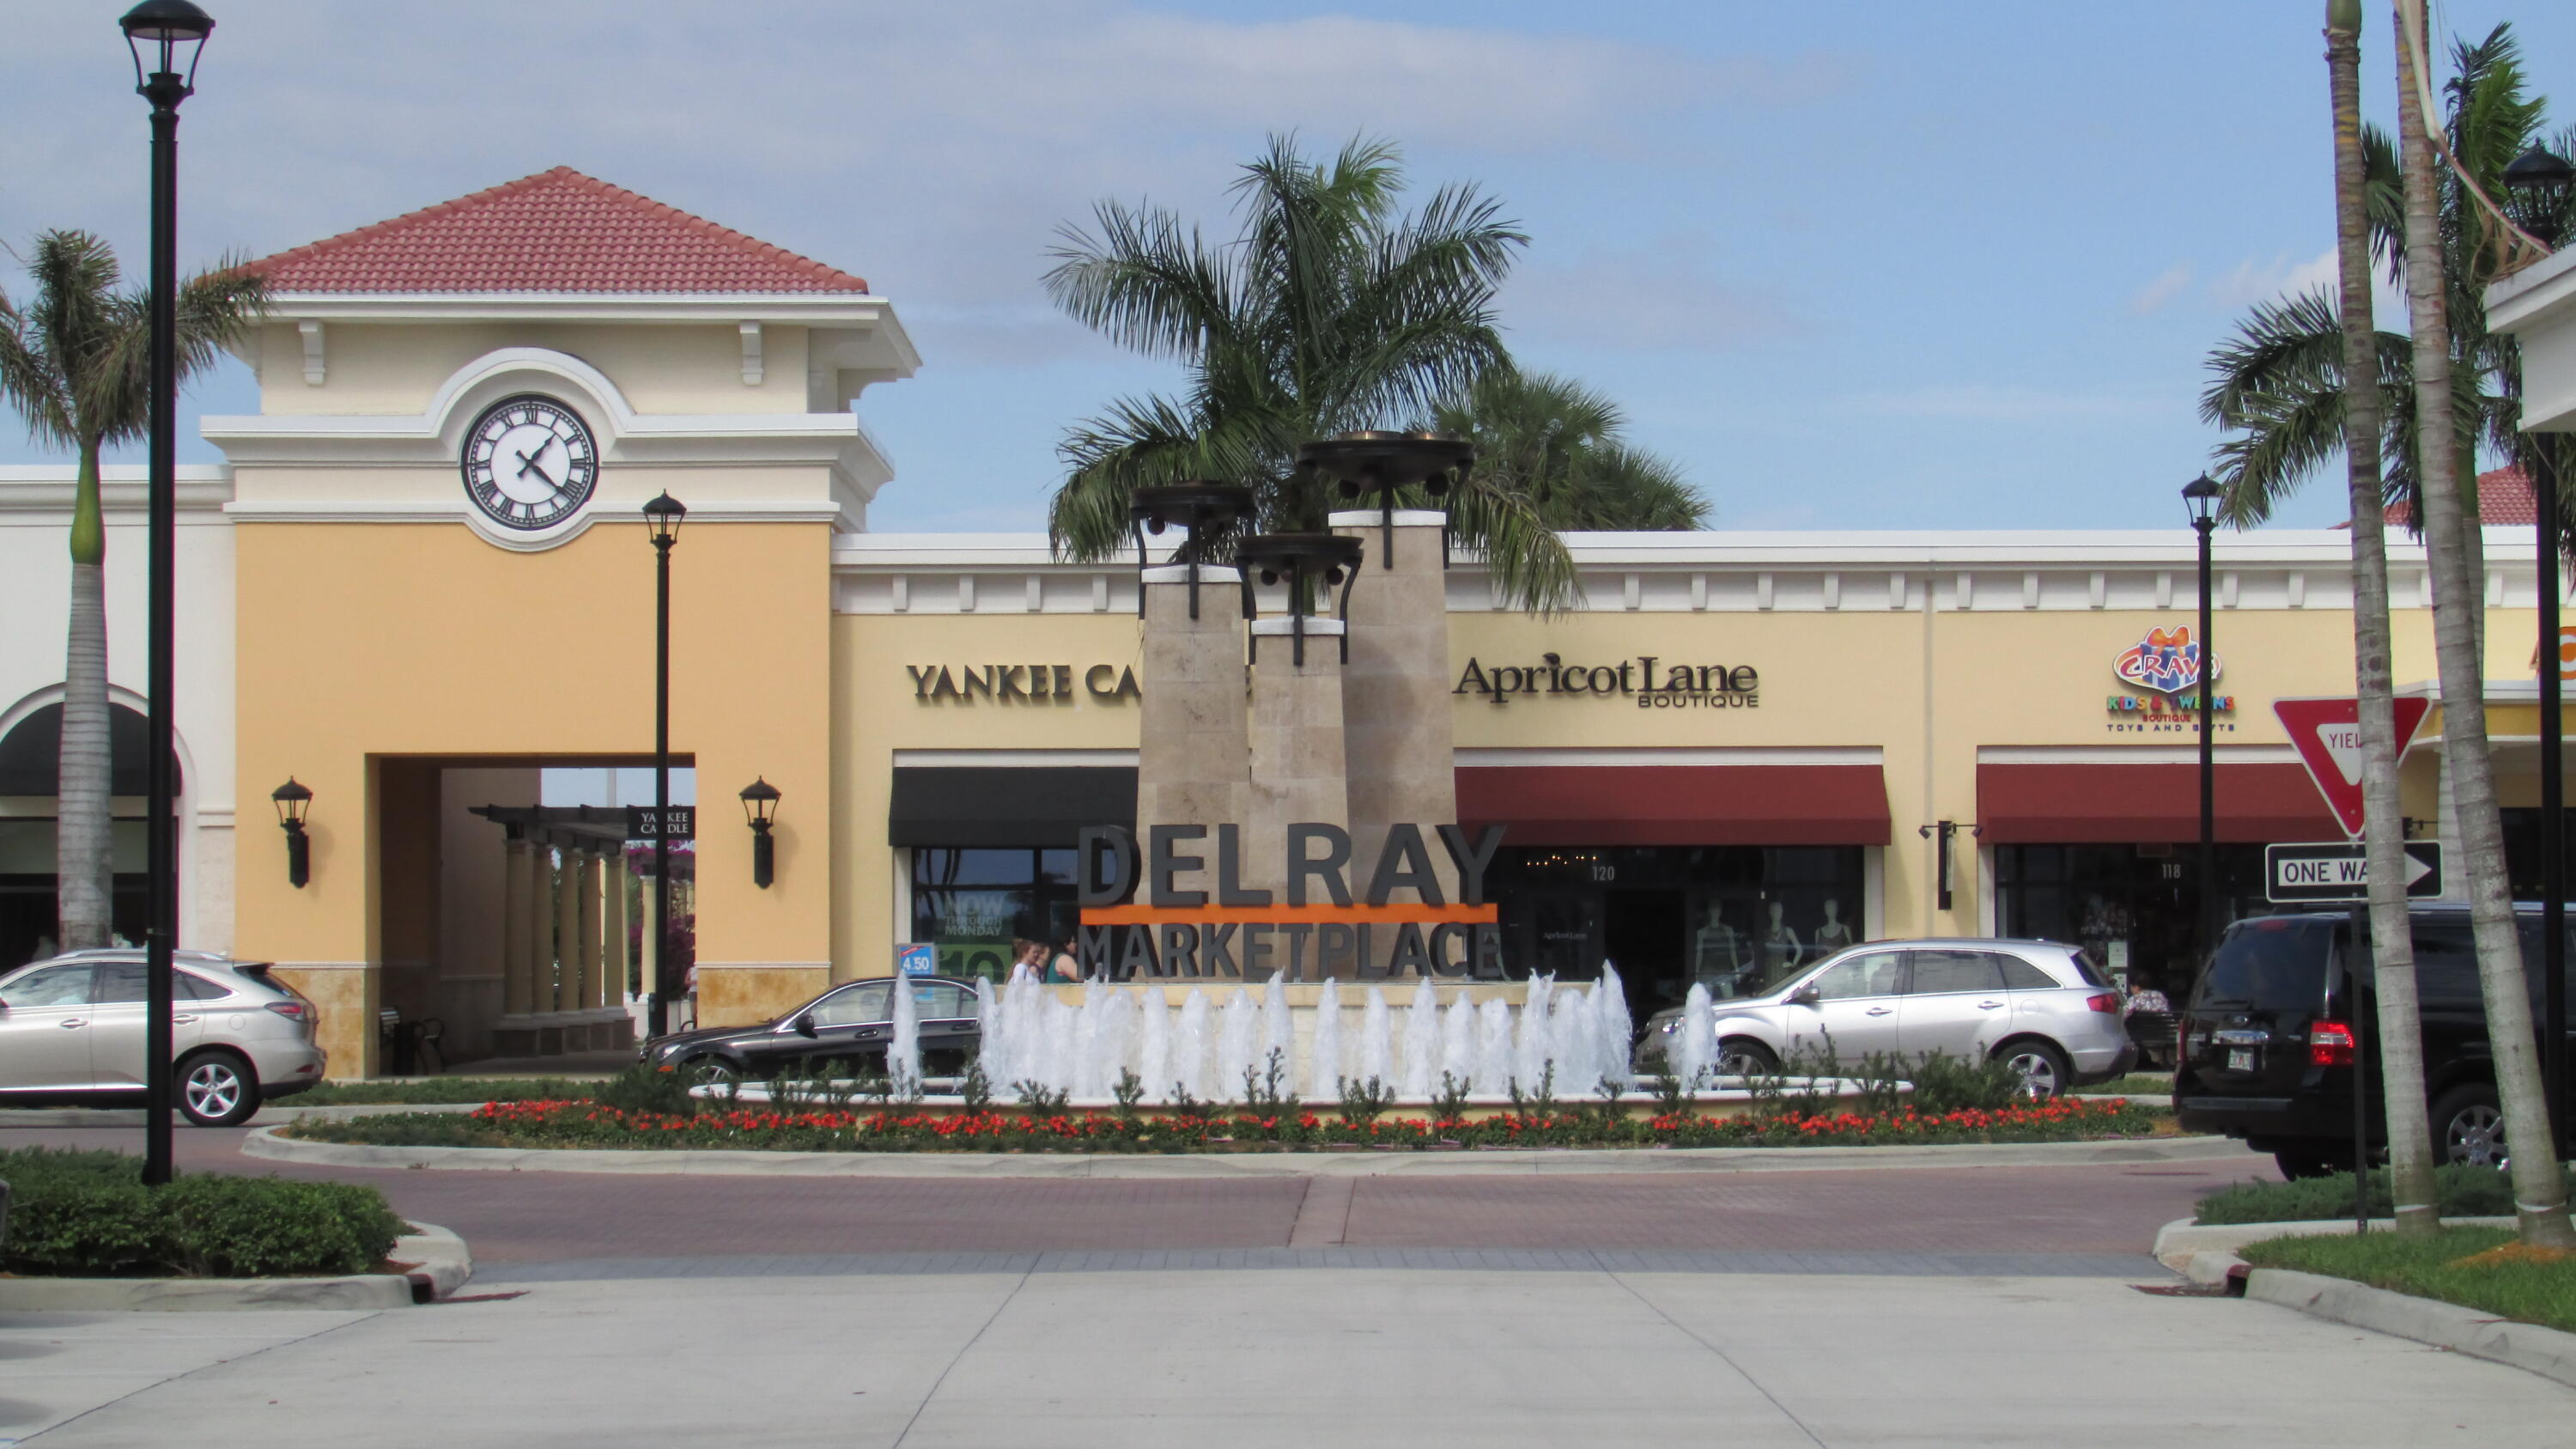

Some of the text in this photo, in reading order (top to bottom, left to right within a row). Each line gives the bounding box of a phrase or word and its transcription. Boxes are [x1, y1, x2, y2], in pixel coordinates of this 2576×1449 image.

[2120, 655, 2214, 678] CRAV
[906, 665, 1072, 697] YANKEE
[1452, 653, 1759, 703] Apricot Lane
[1638, 695, 1759, 709] BOUTIQUE
[2107, 696, 2235, 710] KIDS & TWENS
[2330, 733, 2361, 749] YIEL
[641, 813, 688, 823] YAKEE
[641, 825, 688, 834] CADLE
[1078, 823, 1508, 909] DELRAY
[1592, 866, 1614, 880] 120
[2162, 864, 2181, 879] 118
[2284, 861, 2367, 883] ONE WA
[945, 894, 1005, 916] NOW
[945, 916, 1003, 926] THROUGH
[945, 926, 1003, 936] MONDAY
[1078, 922, 1501, 979] MARKETPLACE
